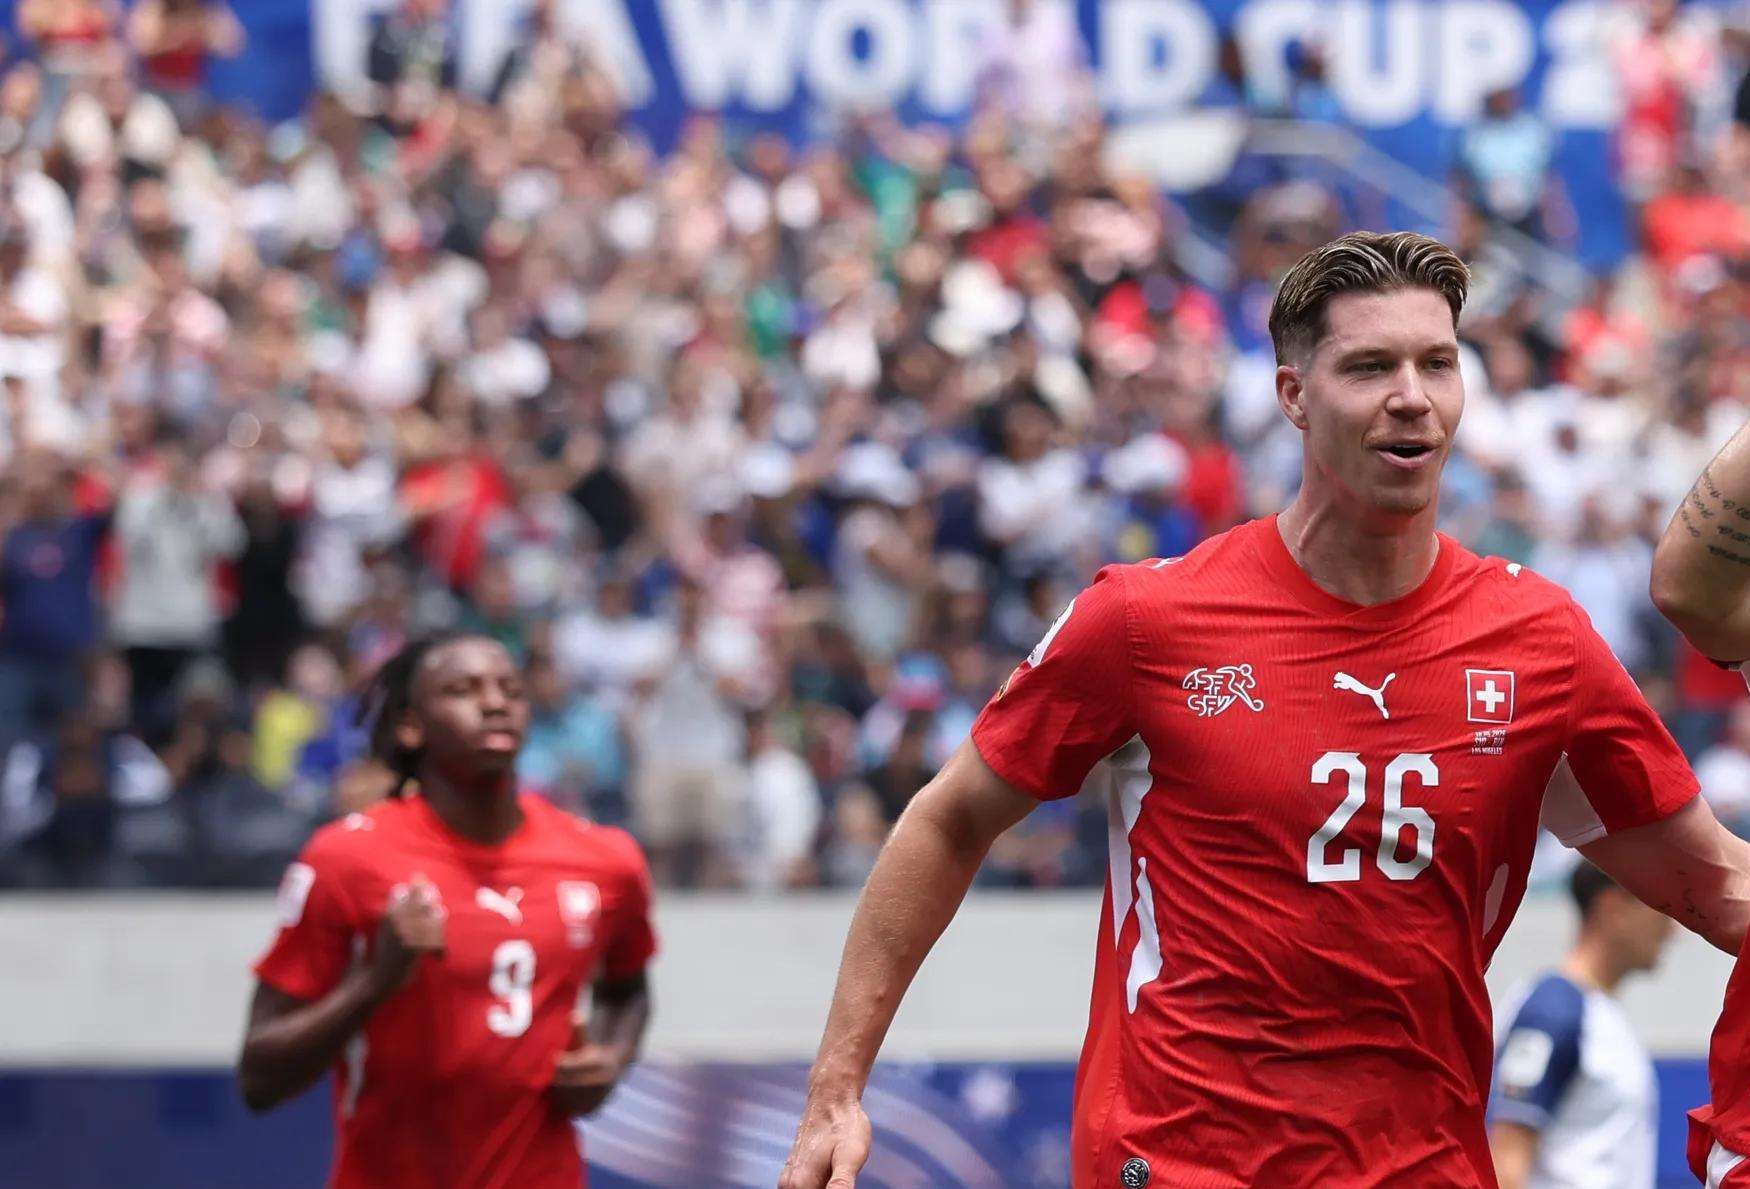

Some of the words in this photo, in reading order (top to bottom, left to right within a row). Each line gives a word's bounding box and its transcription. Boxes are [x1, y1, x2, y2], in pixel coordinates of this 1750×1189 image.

[655, 0, 1217, 112] WORD
[1306, 751, 1440, 883] 26
[487, 939, 536, 1037] 9
